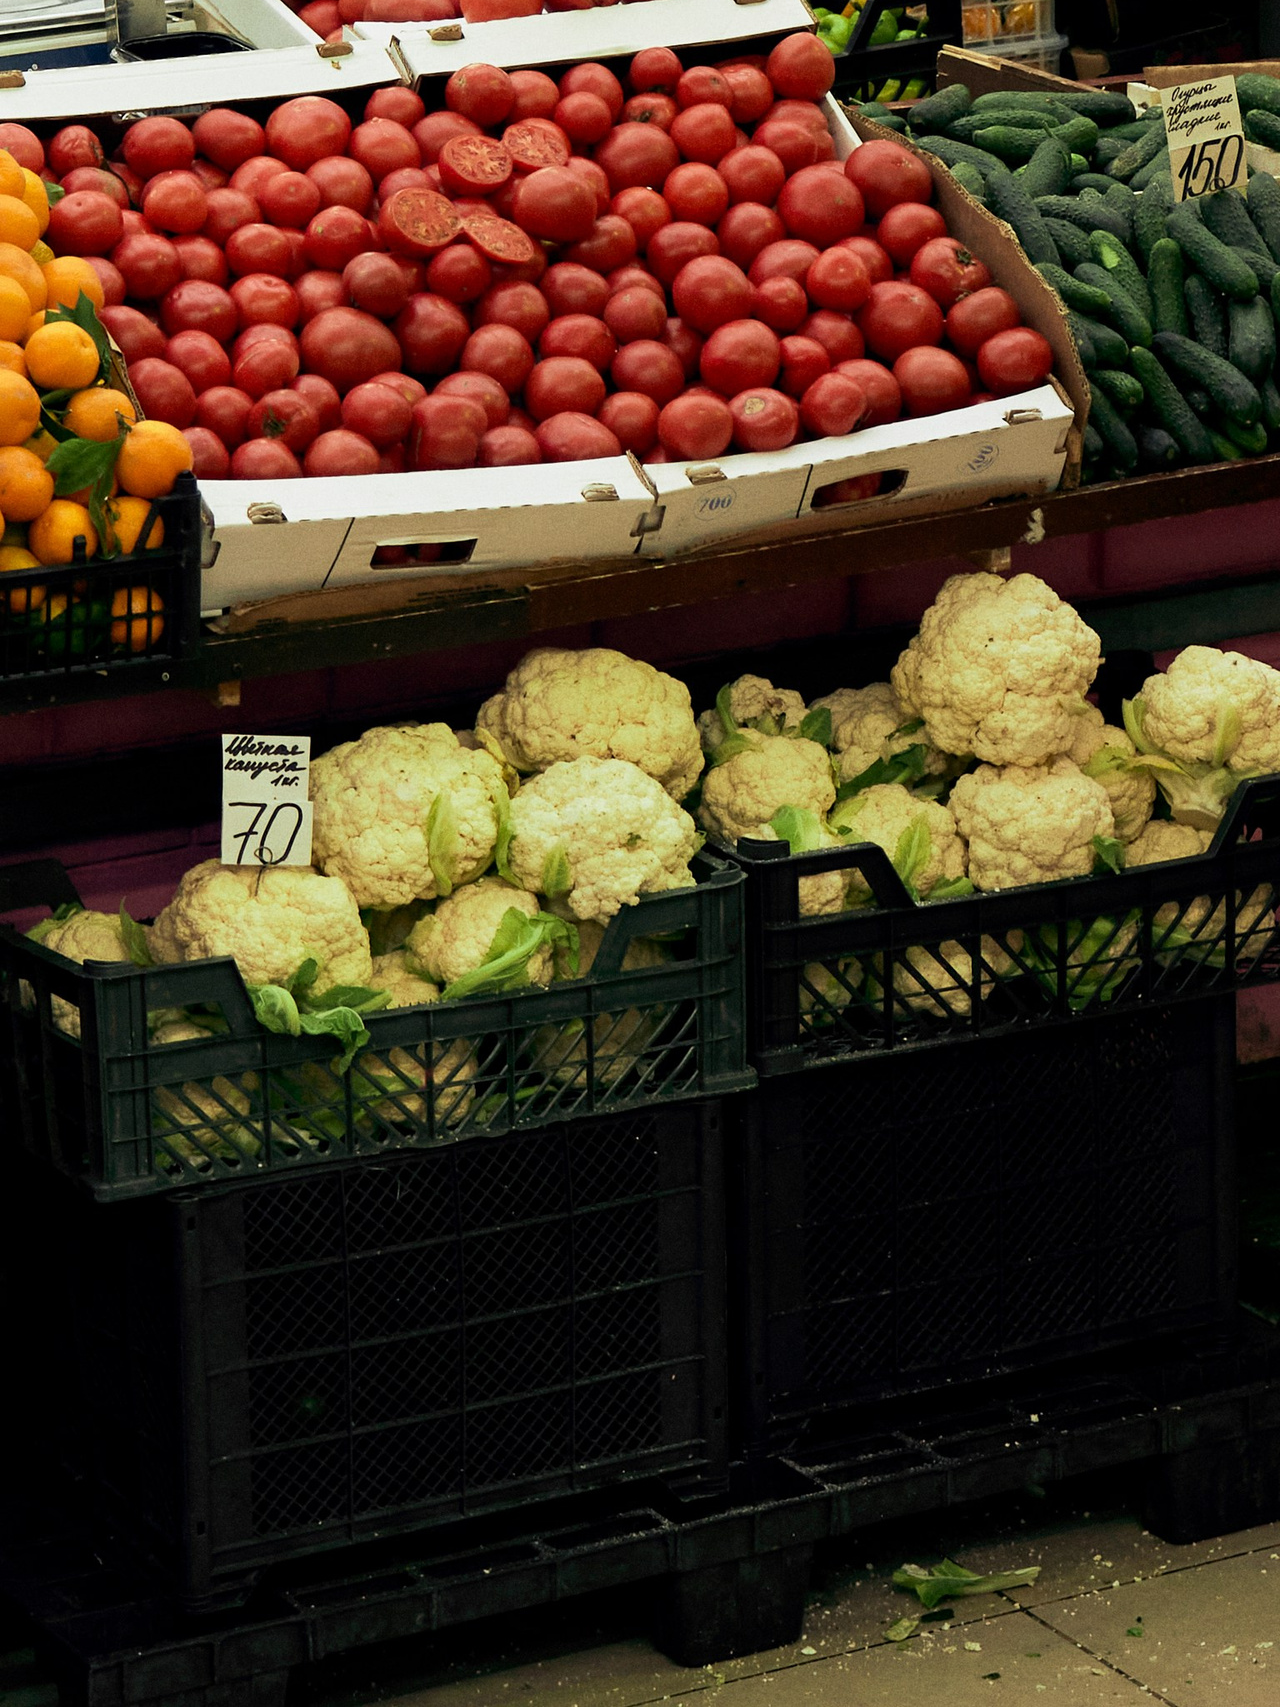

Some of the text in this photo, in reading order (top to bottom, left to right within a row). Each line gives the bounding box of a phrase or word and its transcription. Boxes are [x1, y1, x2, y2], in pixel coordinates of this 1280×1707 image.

[1178, 134, 1244, 202] 150
[224, 758, 307, 780] капуста
[228, 802, 303, 865] 70
